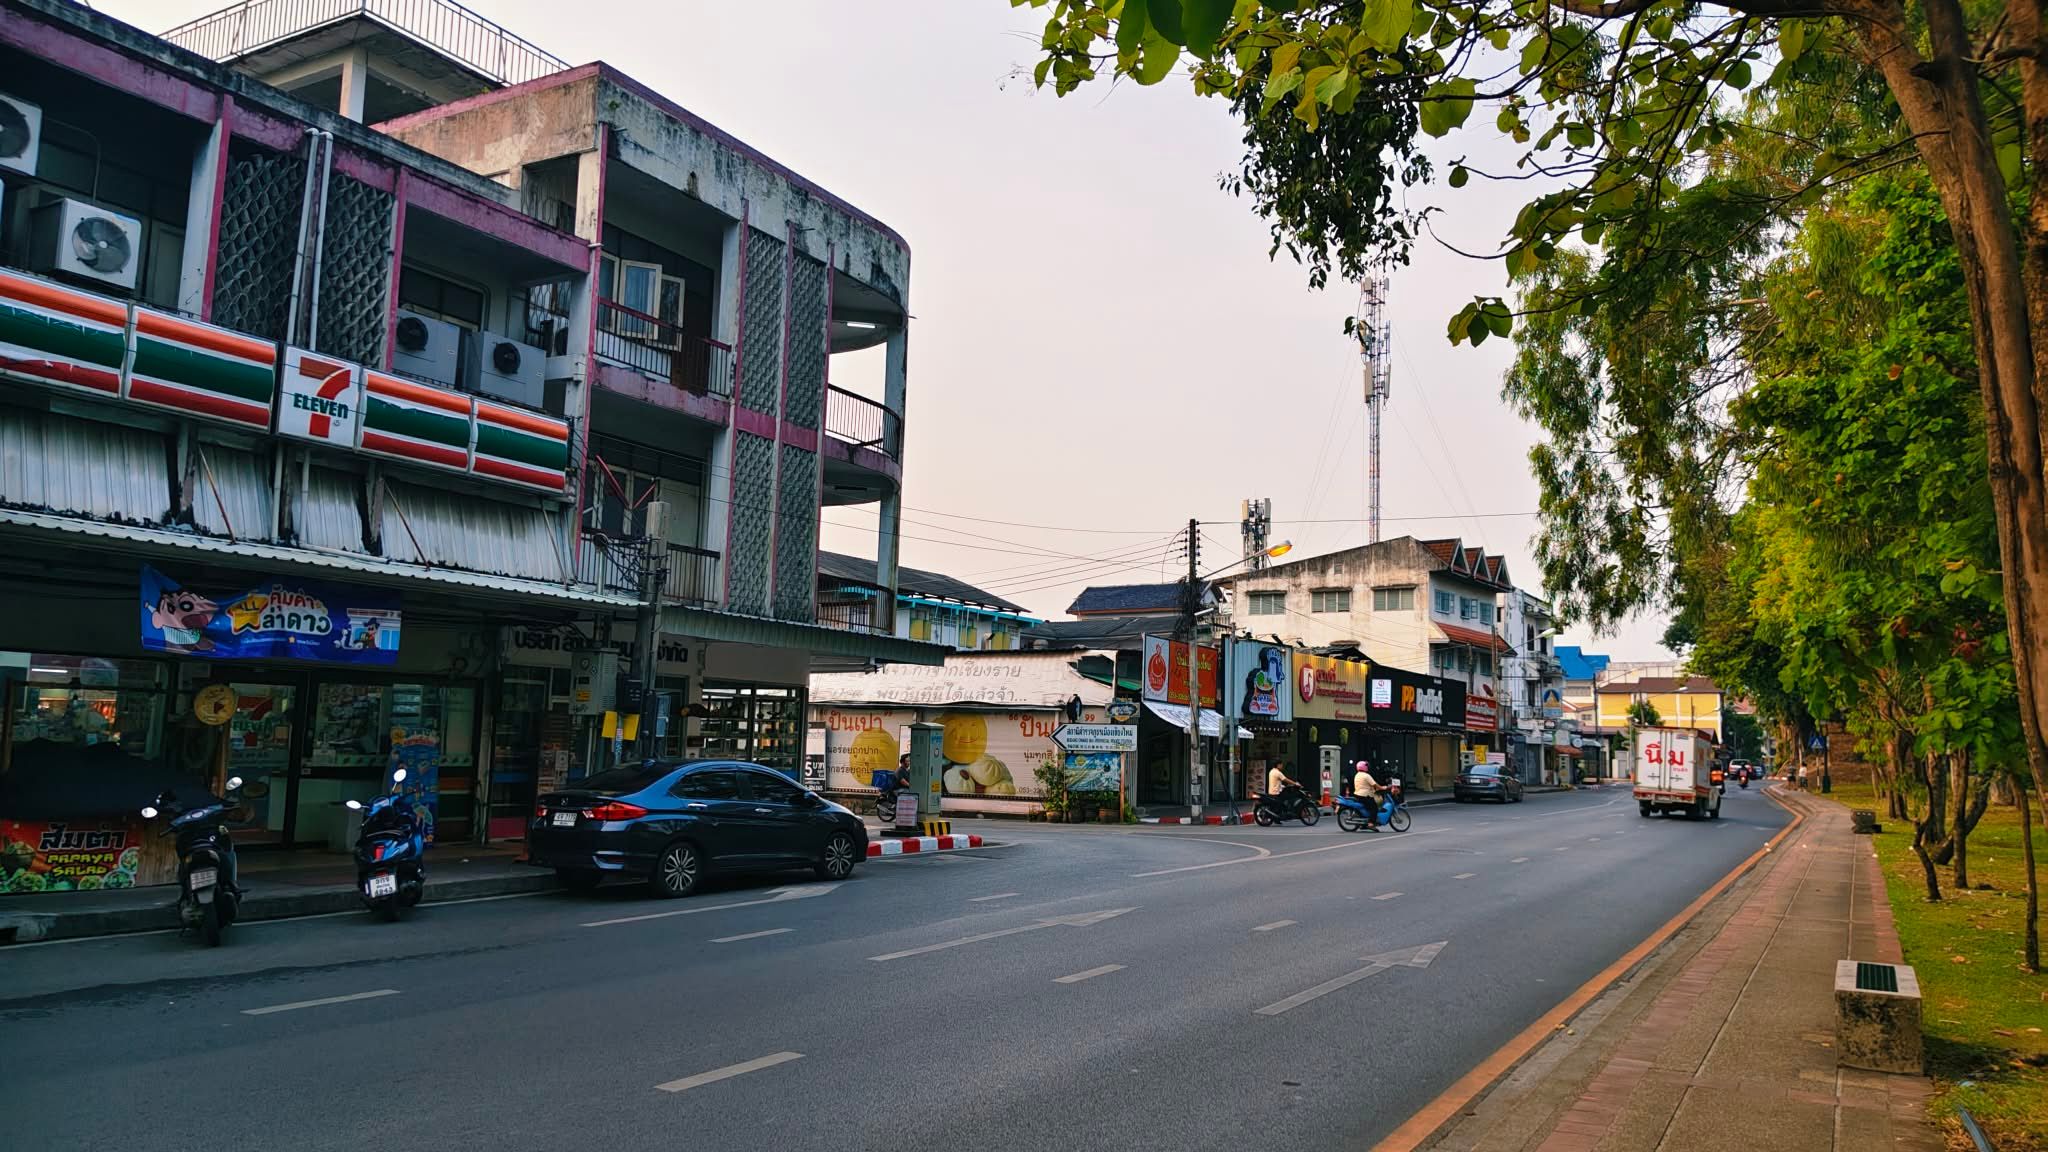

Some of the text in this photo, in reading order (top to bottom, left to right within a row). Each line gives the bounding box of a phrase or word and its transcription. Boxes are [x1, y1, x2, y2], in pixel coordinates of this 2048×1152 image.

[293, 393, 349, 419] ELEVEn
[299, 356, 351, 438] 7
[39, 822, 128, 851] ส้มตำ
[47, 853, 114, 865] PAPAYA
[52, 865, 108, 877] SALAD
